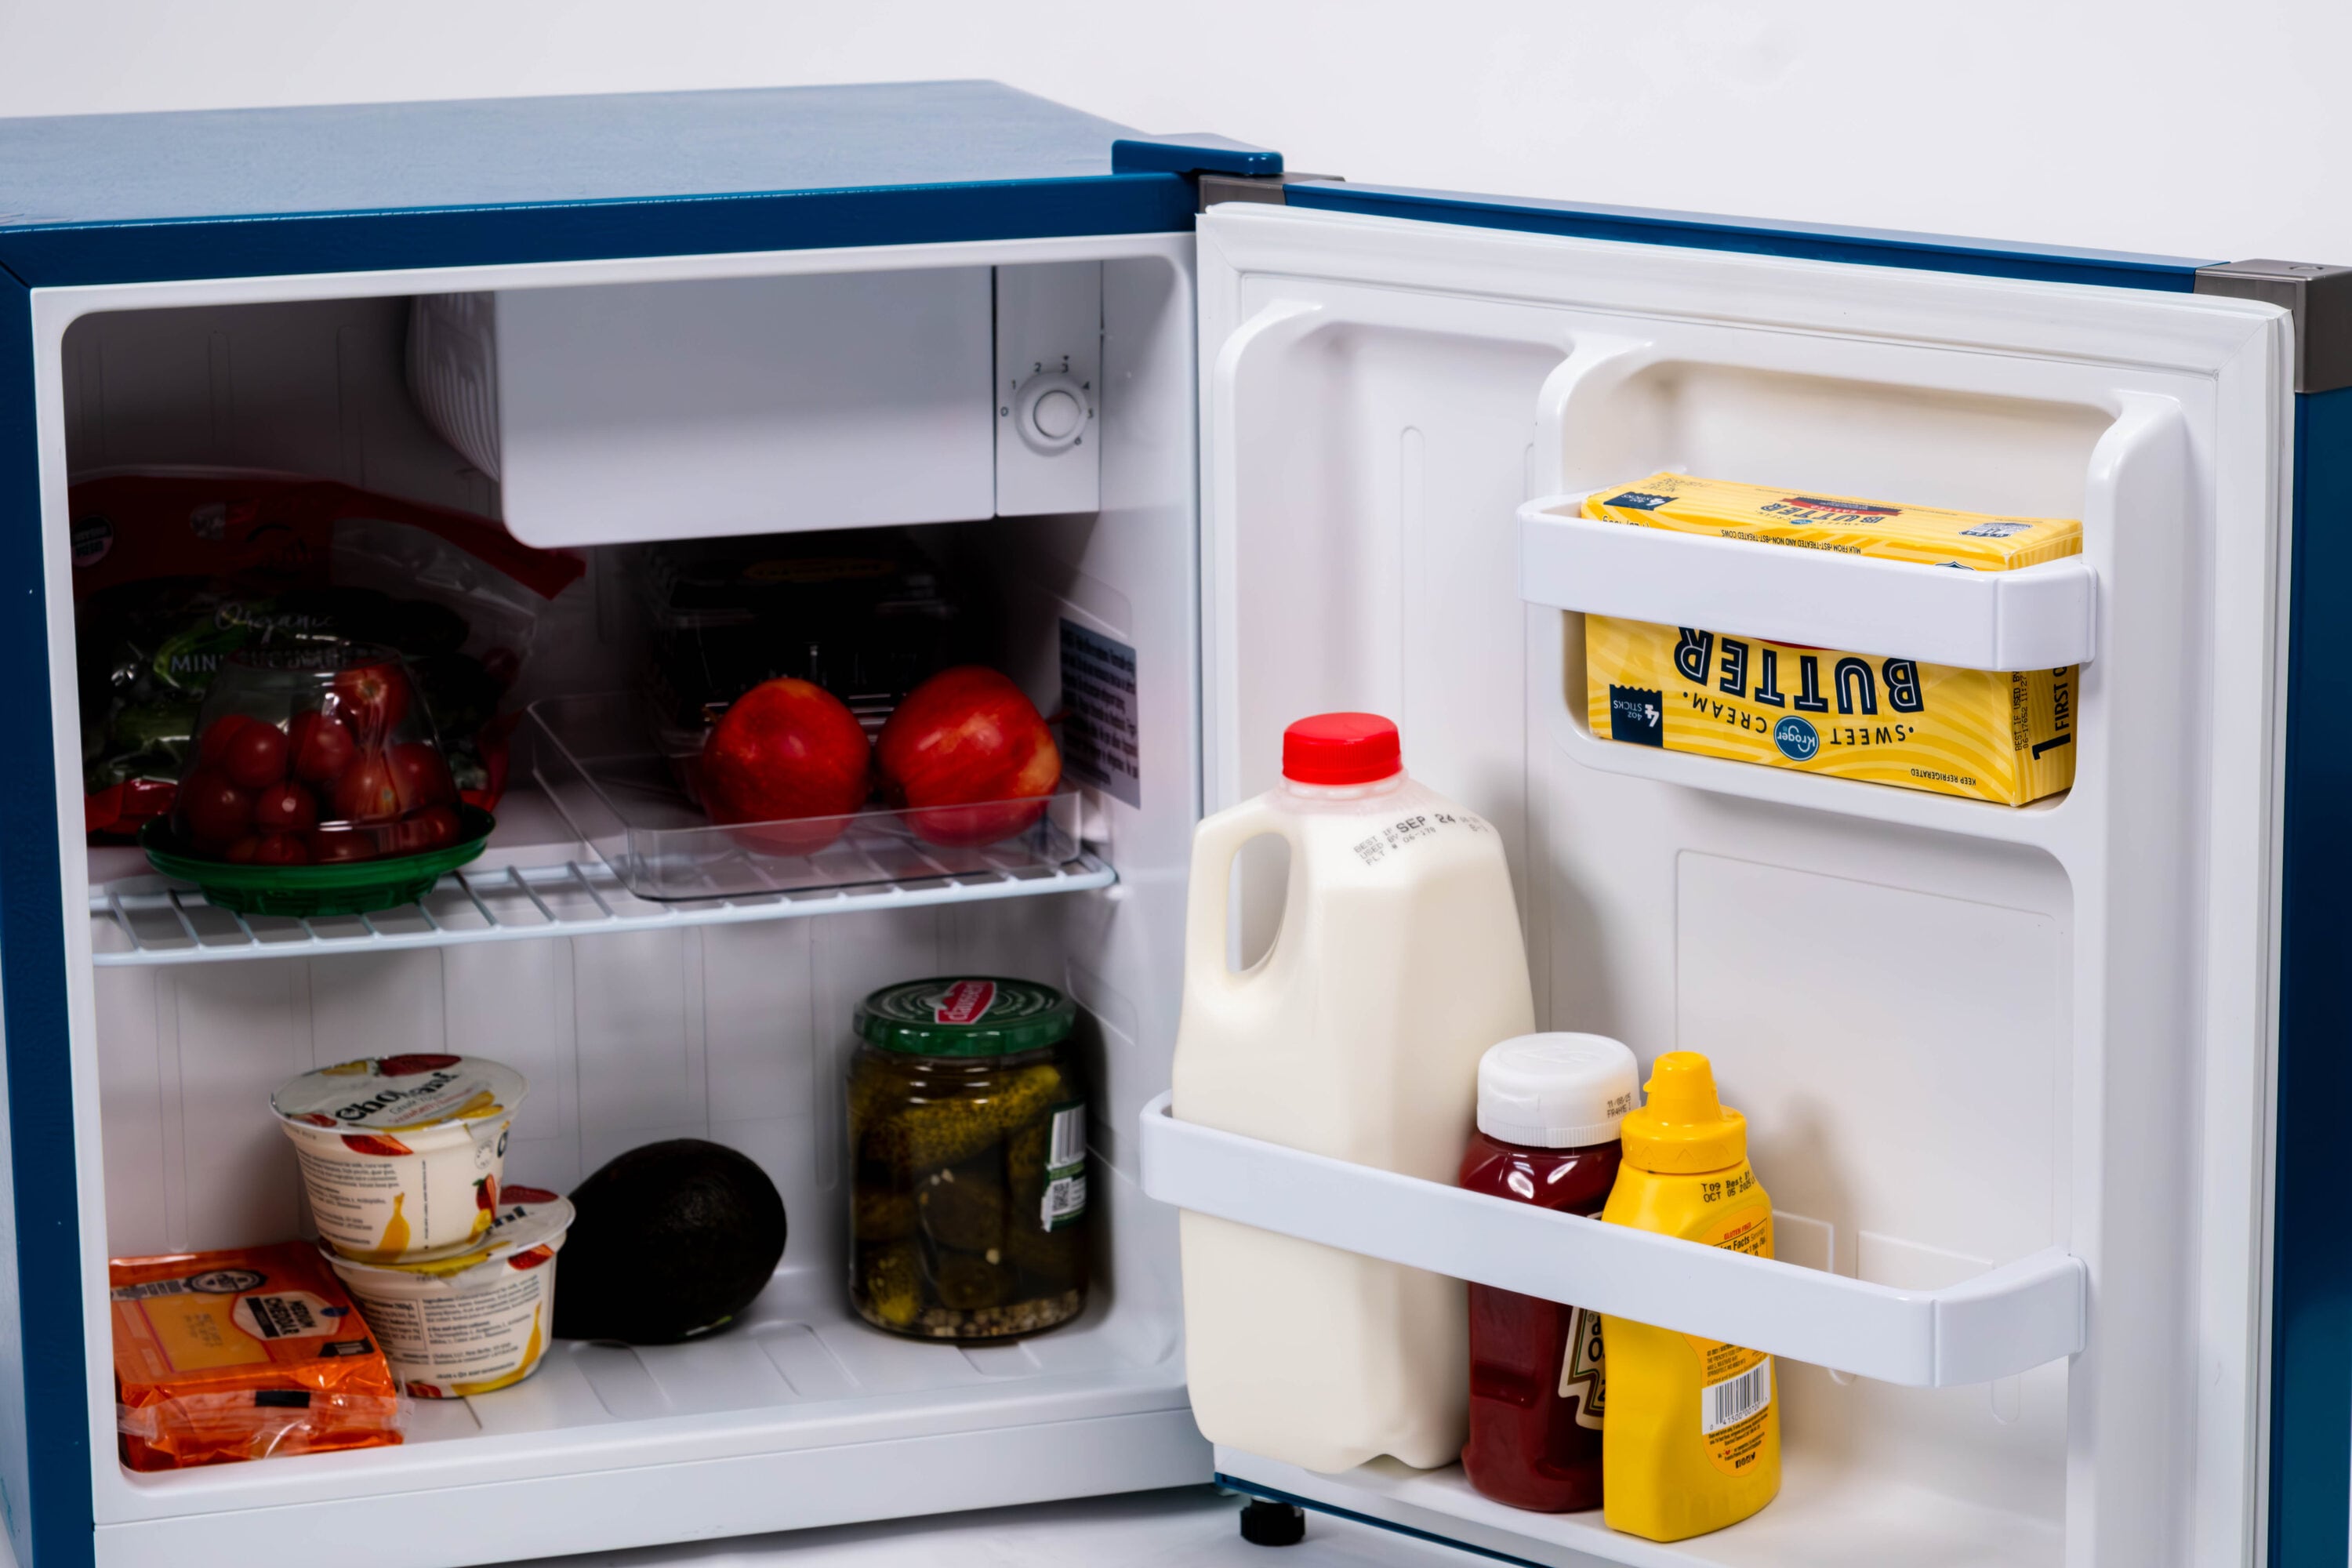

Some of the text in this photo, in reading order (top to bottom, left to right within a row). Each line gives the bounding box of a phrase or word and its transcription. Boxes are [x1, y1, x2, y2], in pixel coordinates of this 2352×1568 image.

[1034, 362, 1069, 373] 2 3
[1761, 503, 1884, 523] BUTTER
[1786, 539, 1795, 547] AND
[1833, 544, 1848, 554] FROM
[1849, 546, 1861, 554] MILK
[1674, 626, 1924, 715] BUTTER
[1613, 699, 1643, 712] STICKS
[2013, 688, 2022, 710] USED
[1645, 703, 1661, 728] 4
[1693, 695, 1905, 746] SWEET CREAM
[2013, 716, 2022, 725] IF
[2031, 733, 2071, 760] 1
[2054, 683, 2070, 731] FIRST
[1776, 728, 1816, 753] Kroger
[2013, 731, 2023, 751] BEST
[1911, 768, 1976, 786] KEEP REFRIGERATED
[1396, 813, 1457, 833] SEP 24
[1353, 836, 1377, 853] BEST
[1360, 843, 1385, 861] USED
[1703, 1192, 1722, 1203] OCT
[1727, 1188, 1737, 1197] 05
[1733, 1236, 1750, 1251] Facts
